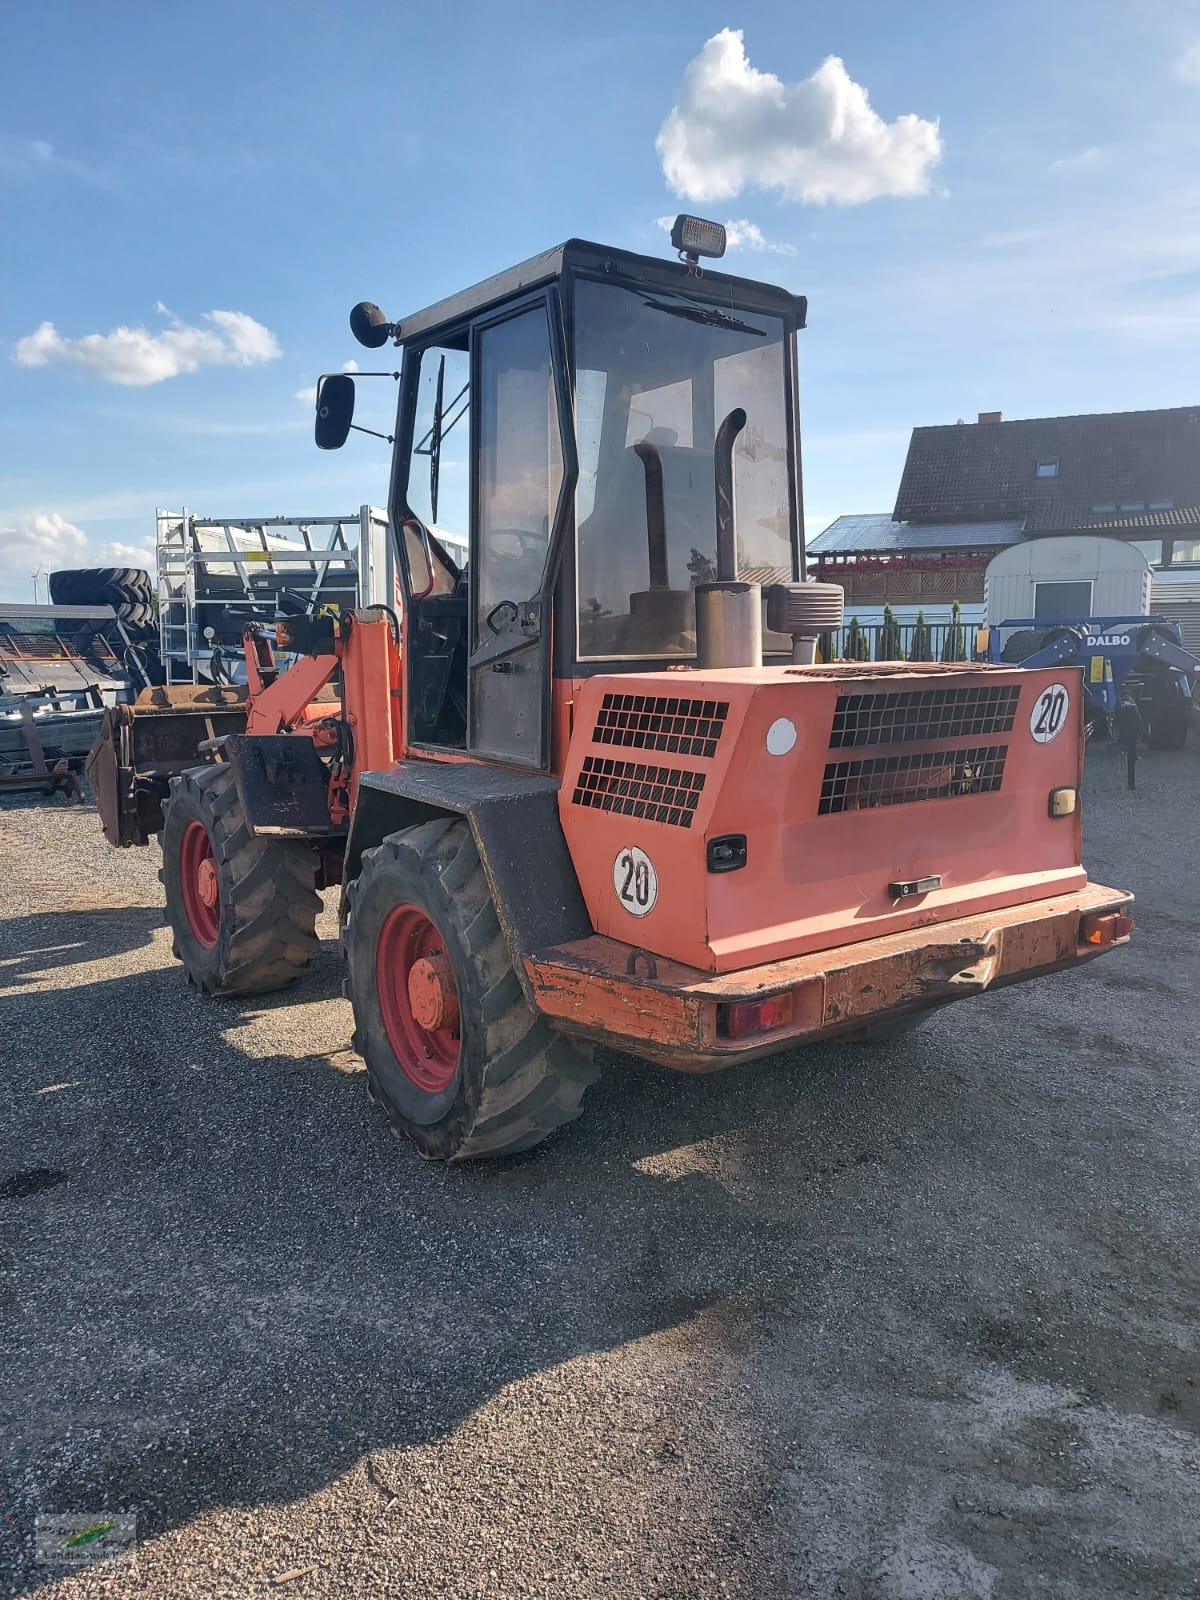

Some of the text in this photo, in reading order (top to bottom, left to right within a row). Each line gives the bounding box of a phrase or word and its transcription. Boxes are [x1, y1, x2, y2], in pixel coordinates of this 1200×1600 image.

[1086, 635, 1131, 647] DALBO
[1034, 692, 1065, 734] 20
[621, 855, 649, 906] 20
